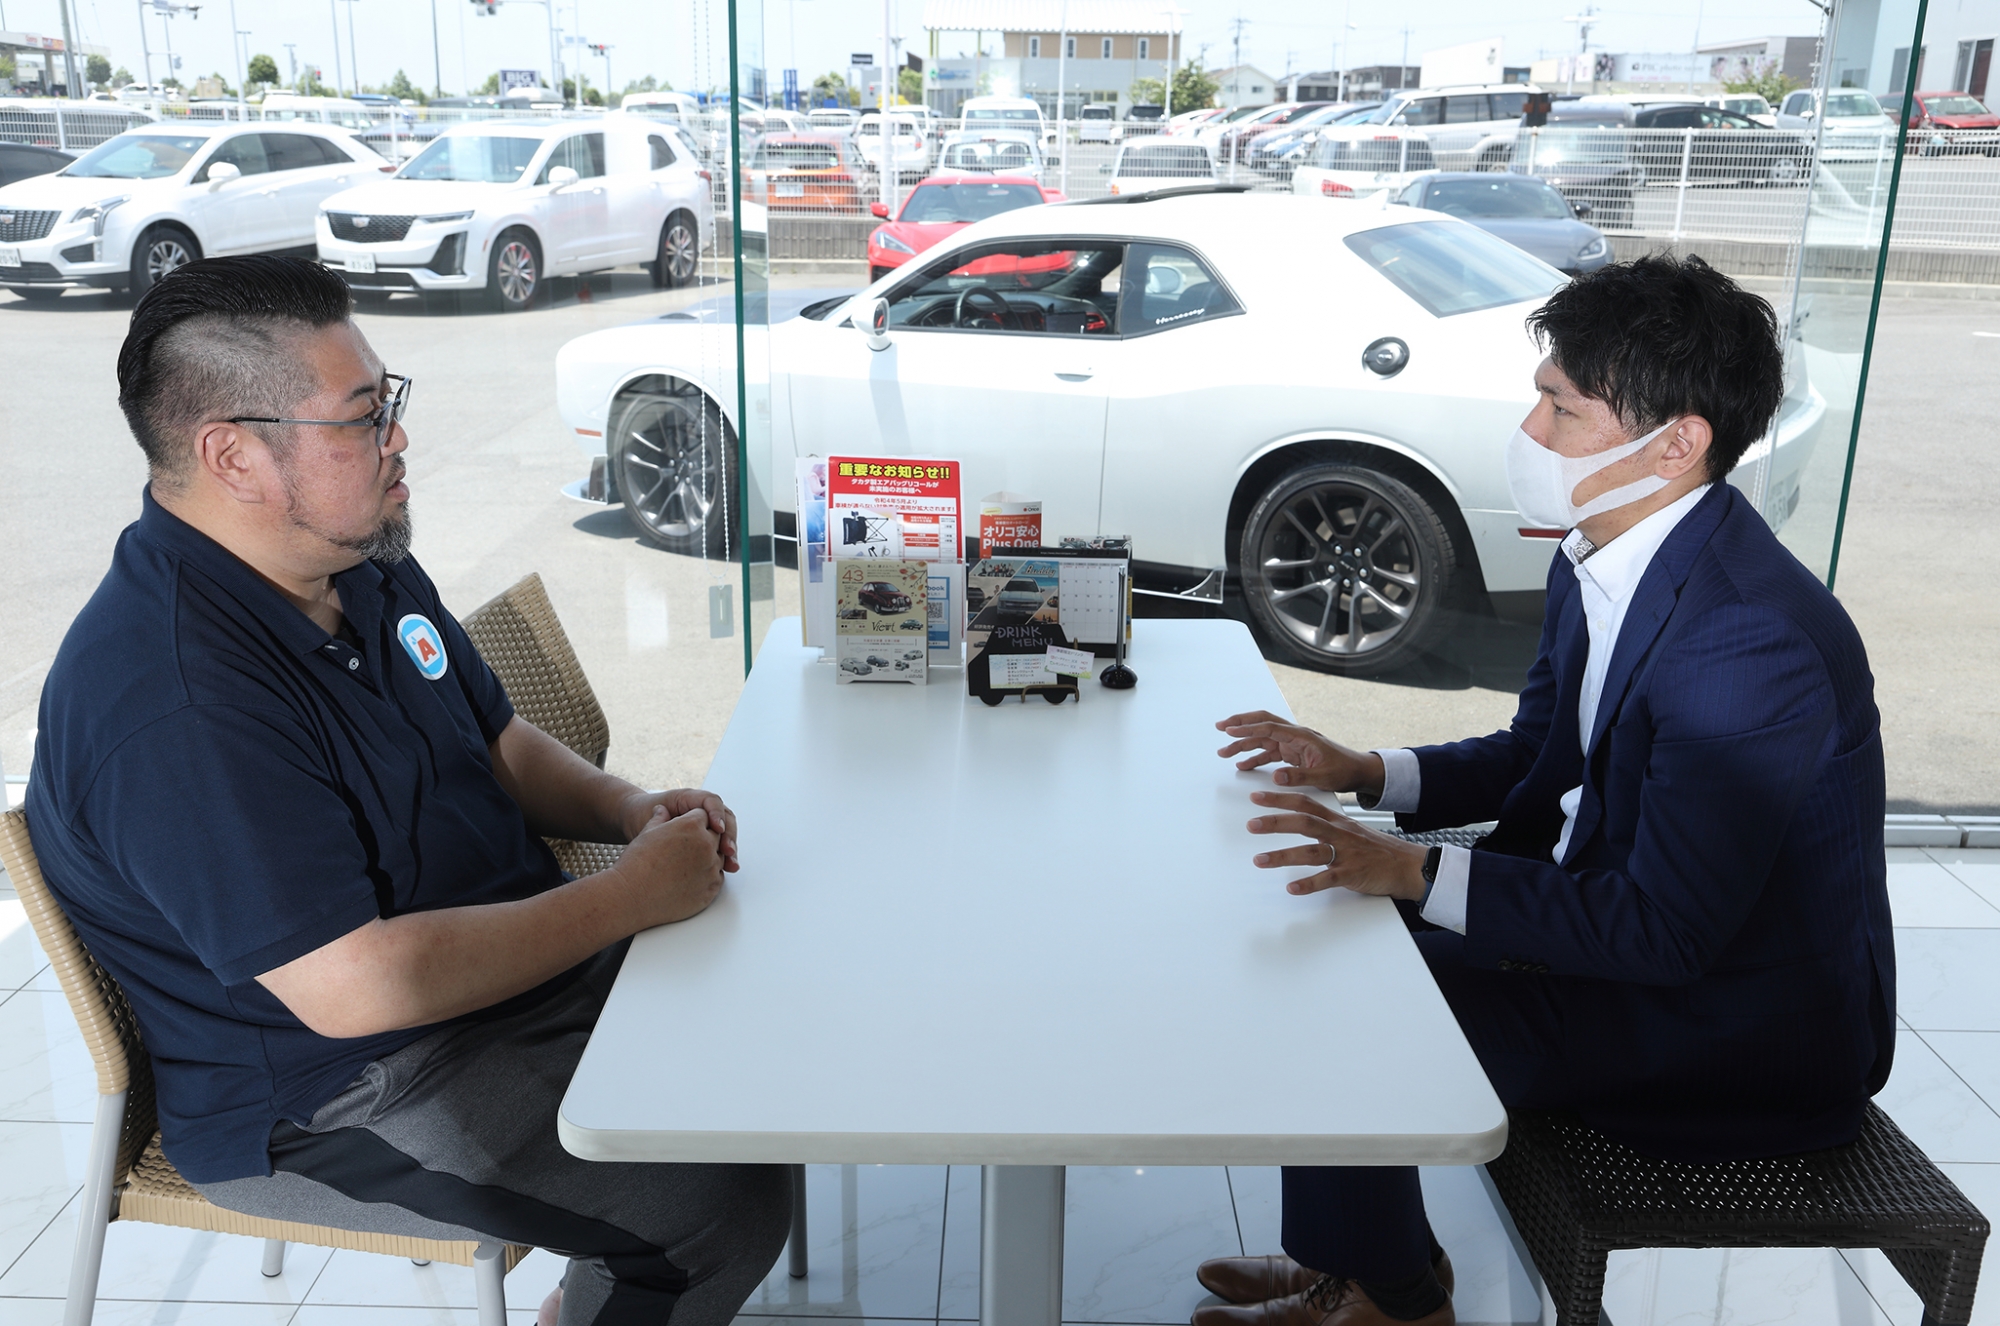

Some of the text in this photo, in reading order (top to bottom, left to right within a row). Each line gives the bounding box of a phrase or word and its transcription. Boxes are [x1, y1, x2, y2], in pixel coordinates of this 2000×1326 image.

[506, 72, 531, 82] BIG
[838, 462, 950, 480] 重要なお知らせ!!
[984, 525, 1039, 537] オリコ安心
[983, 538, 1039, 549] Plus One
[842, 570, 864, 581] 43
[995, 626, 1042, 638] DRINK
[1012, 638, 1053, 647] MENU
[418, 638, 436, 662] A
